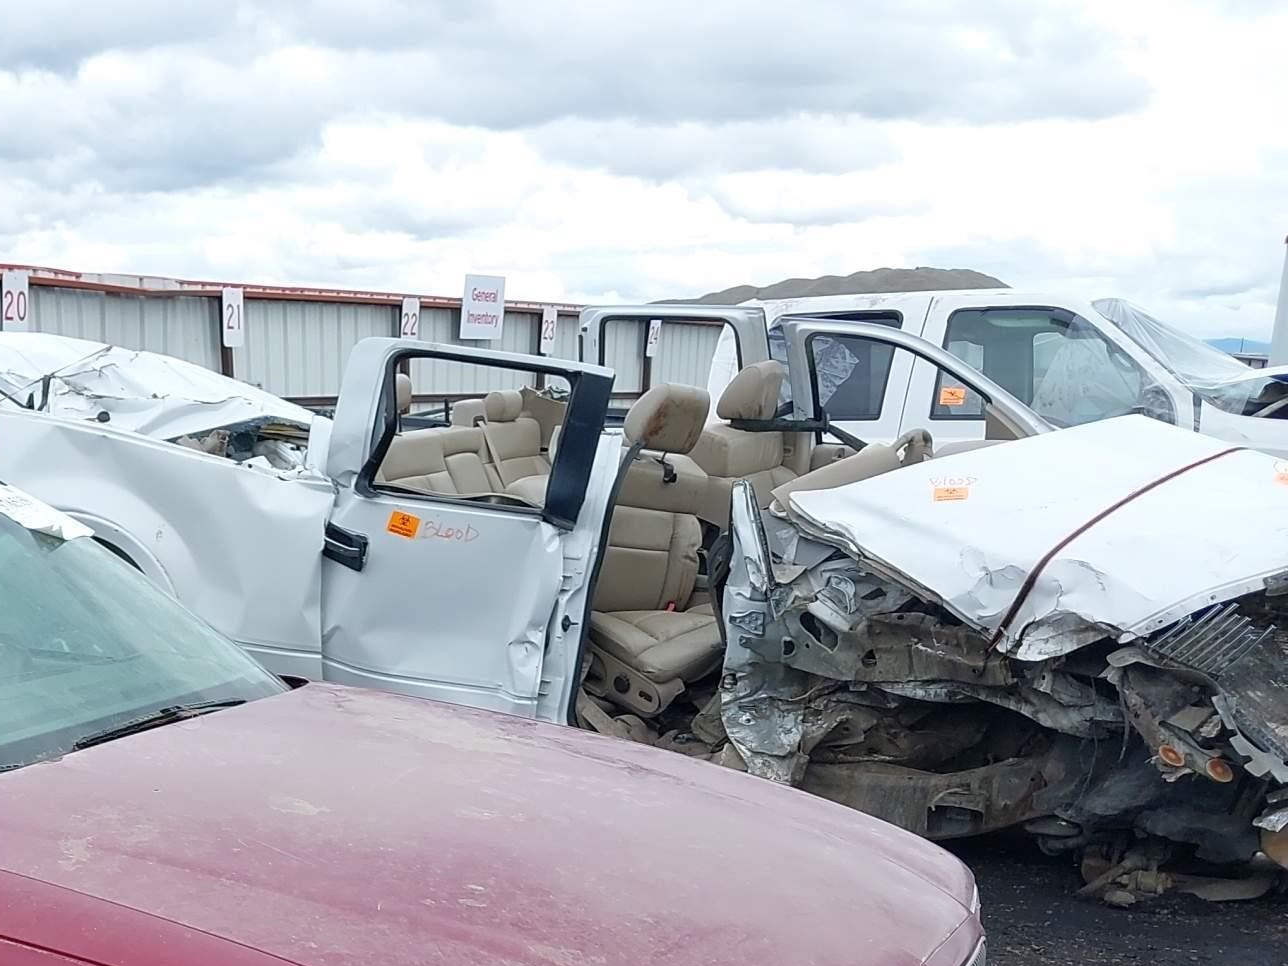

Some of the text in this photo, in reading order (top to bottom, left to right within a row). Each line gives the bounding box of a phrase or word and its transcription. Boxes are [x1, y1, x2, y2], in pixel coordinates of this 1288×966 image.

[4, 290, 27, 322] 20
[472, 287, 499, 303] General
[226, 303, 241, 330] 21
[402, 312, 418, 336] 22
[466, 310, 500, 328] Inventory
[543, 319, 554, 341] 23
